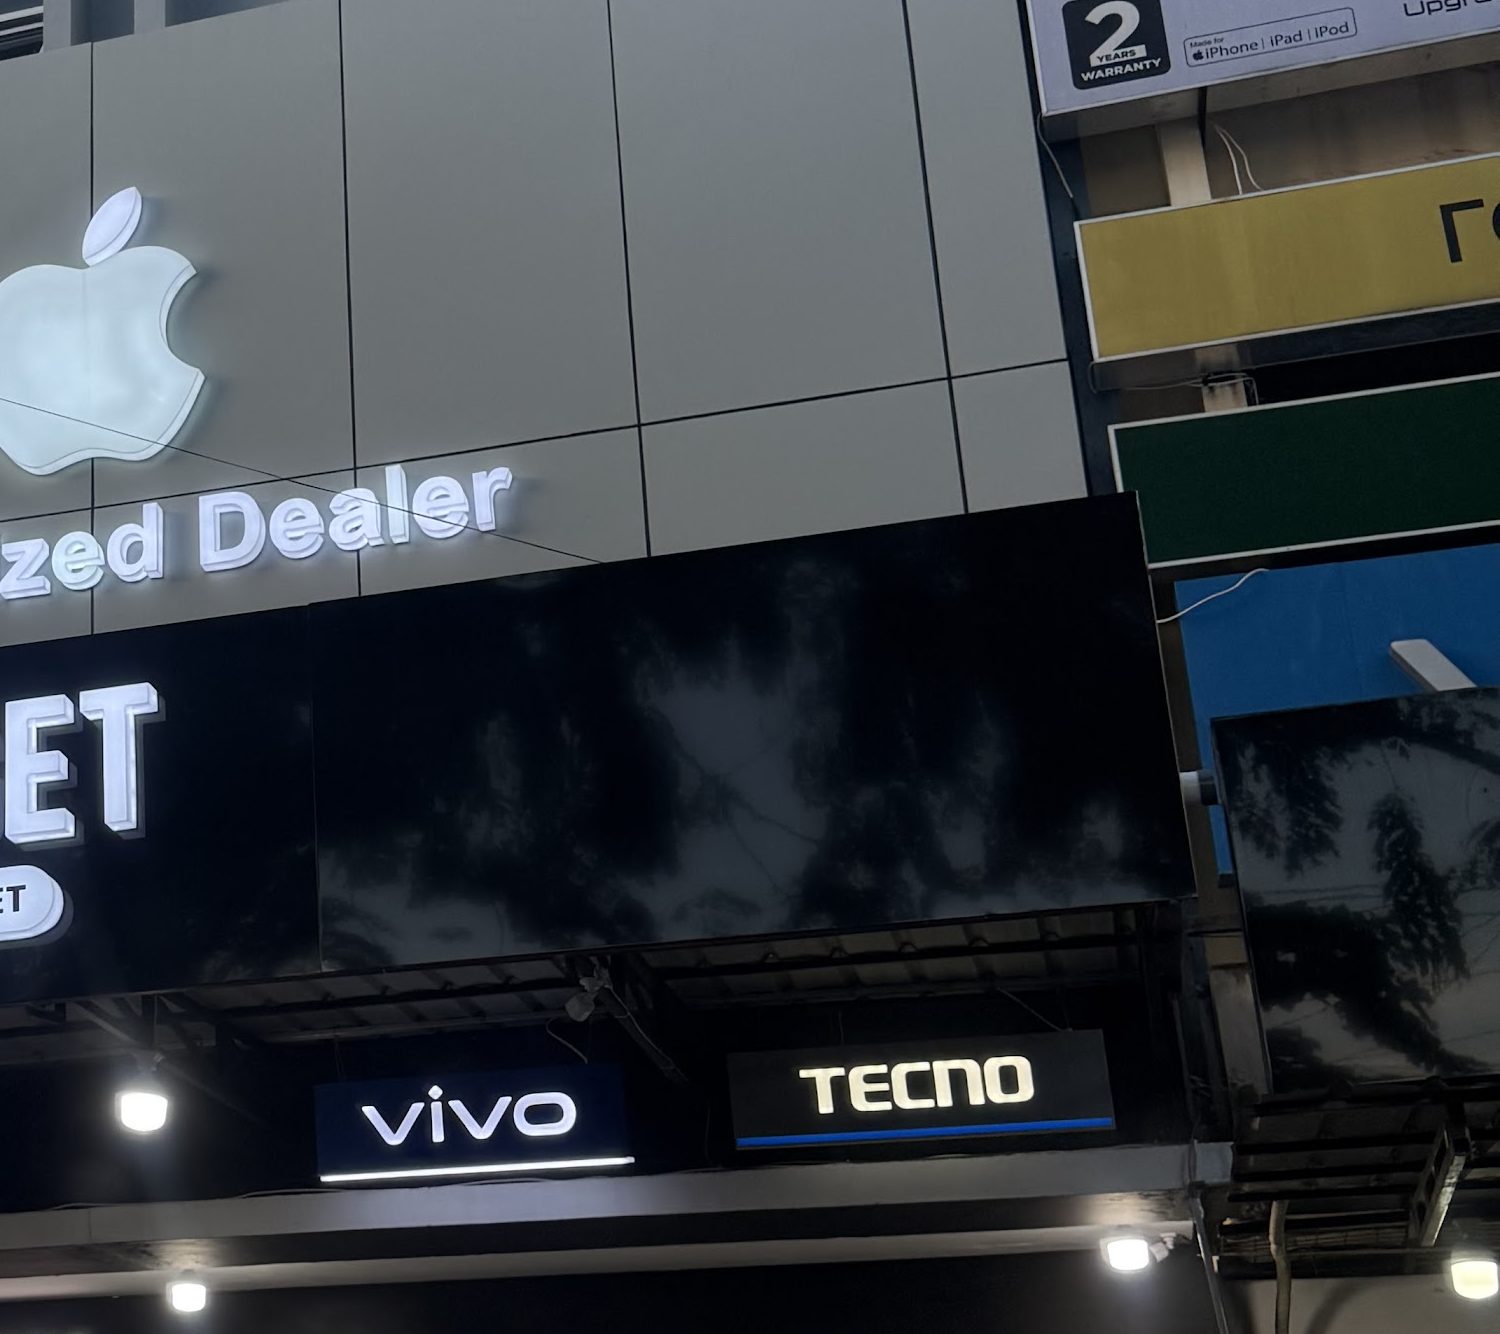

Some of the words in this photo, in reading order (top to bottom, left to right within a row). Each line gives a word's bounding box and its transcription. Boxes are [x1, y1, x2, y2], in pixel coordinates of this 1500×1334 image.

[1084, 0, 1142, 68] 2
[1189, 38, 1209, 48] Made
[1205, 39, 1260, 63] iPhone
[1269, 30, 1303, 48] iPad
[1314, 21, 1350, 40] iPod
[1080, 57, 1163, 83] WARRANTY
[1095, 48, 1137, 63] YEARS
[198, 464, 514, 574] Dealer
[361, 1084, 578, 1146] vivo
